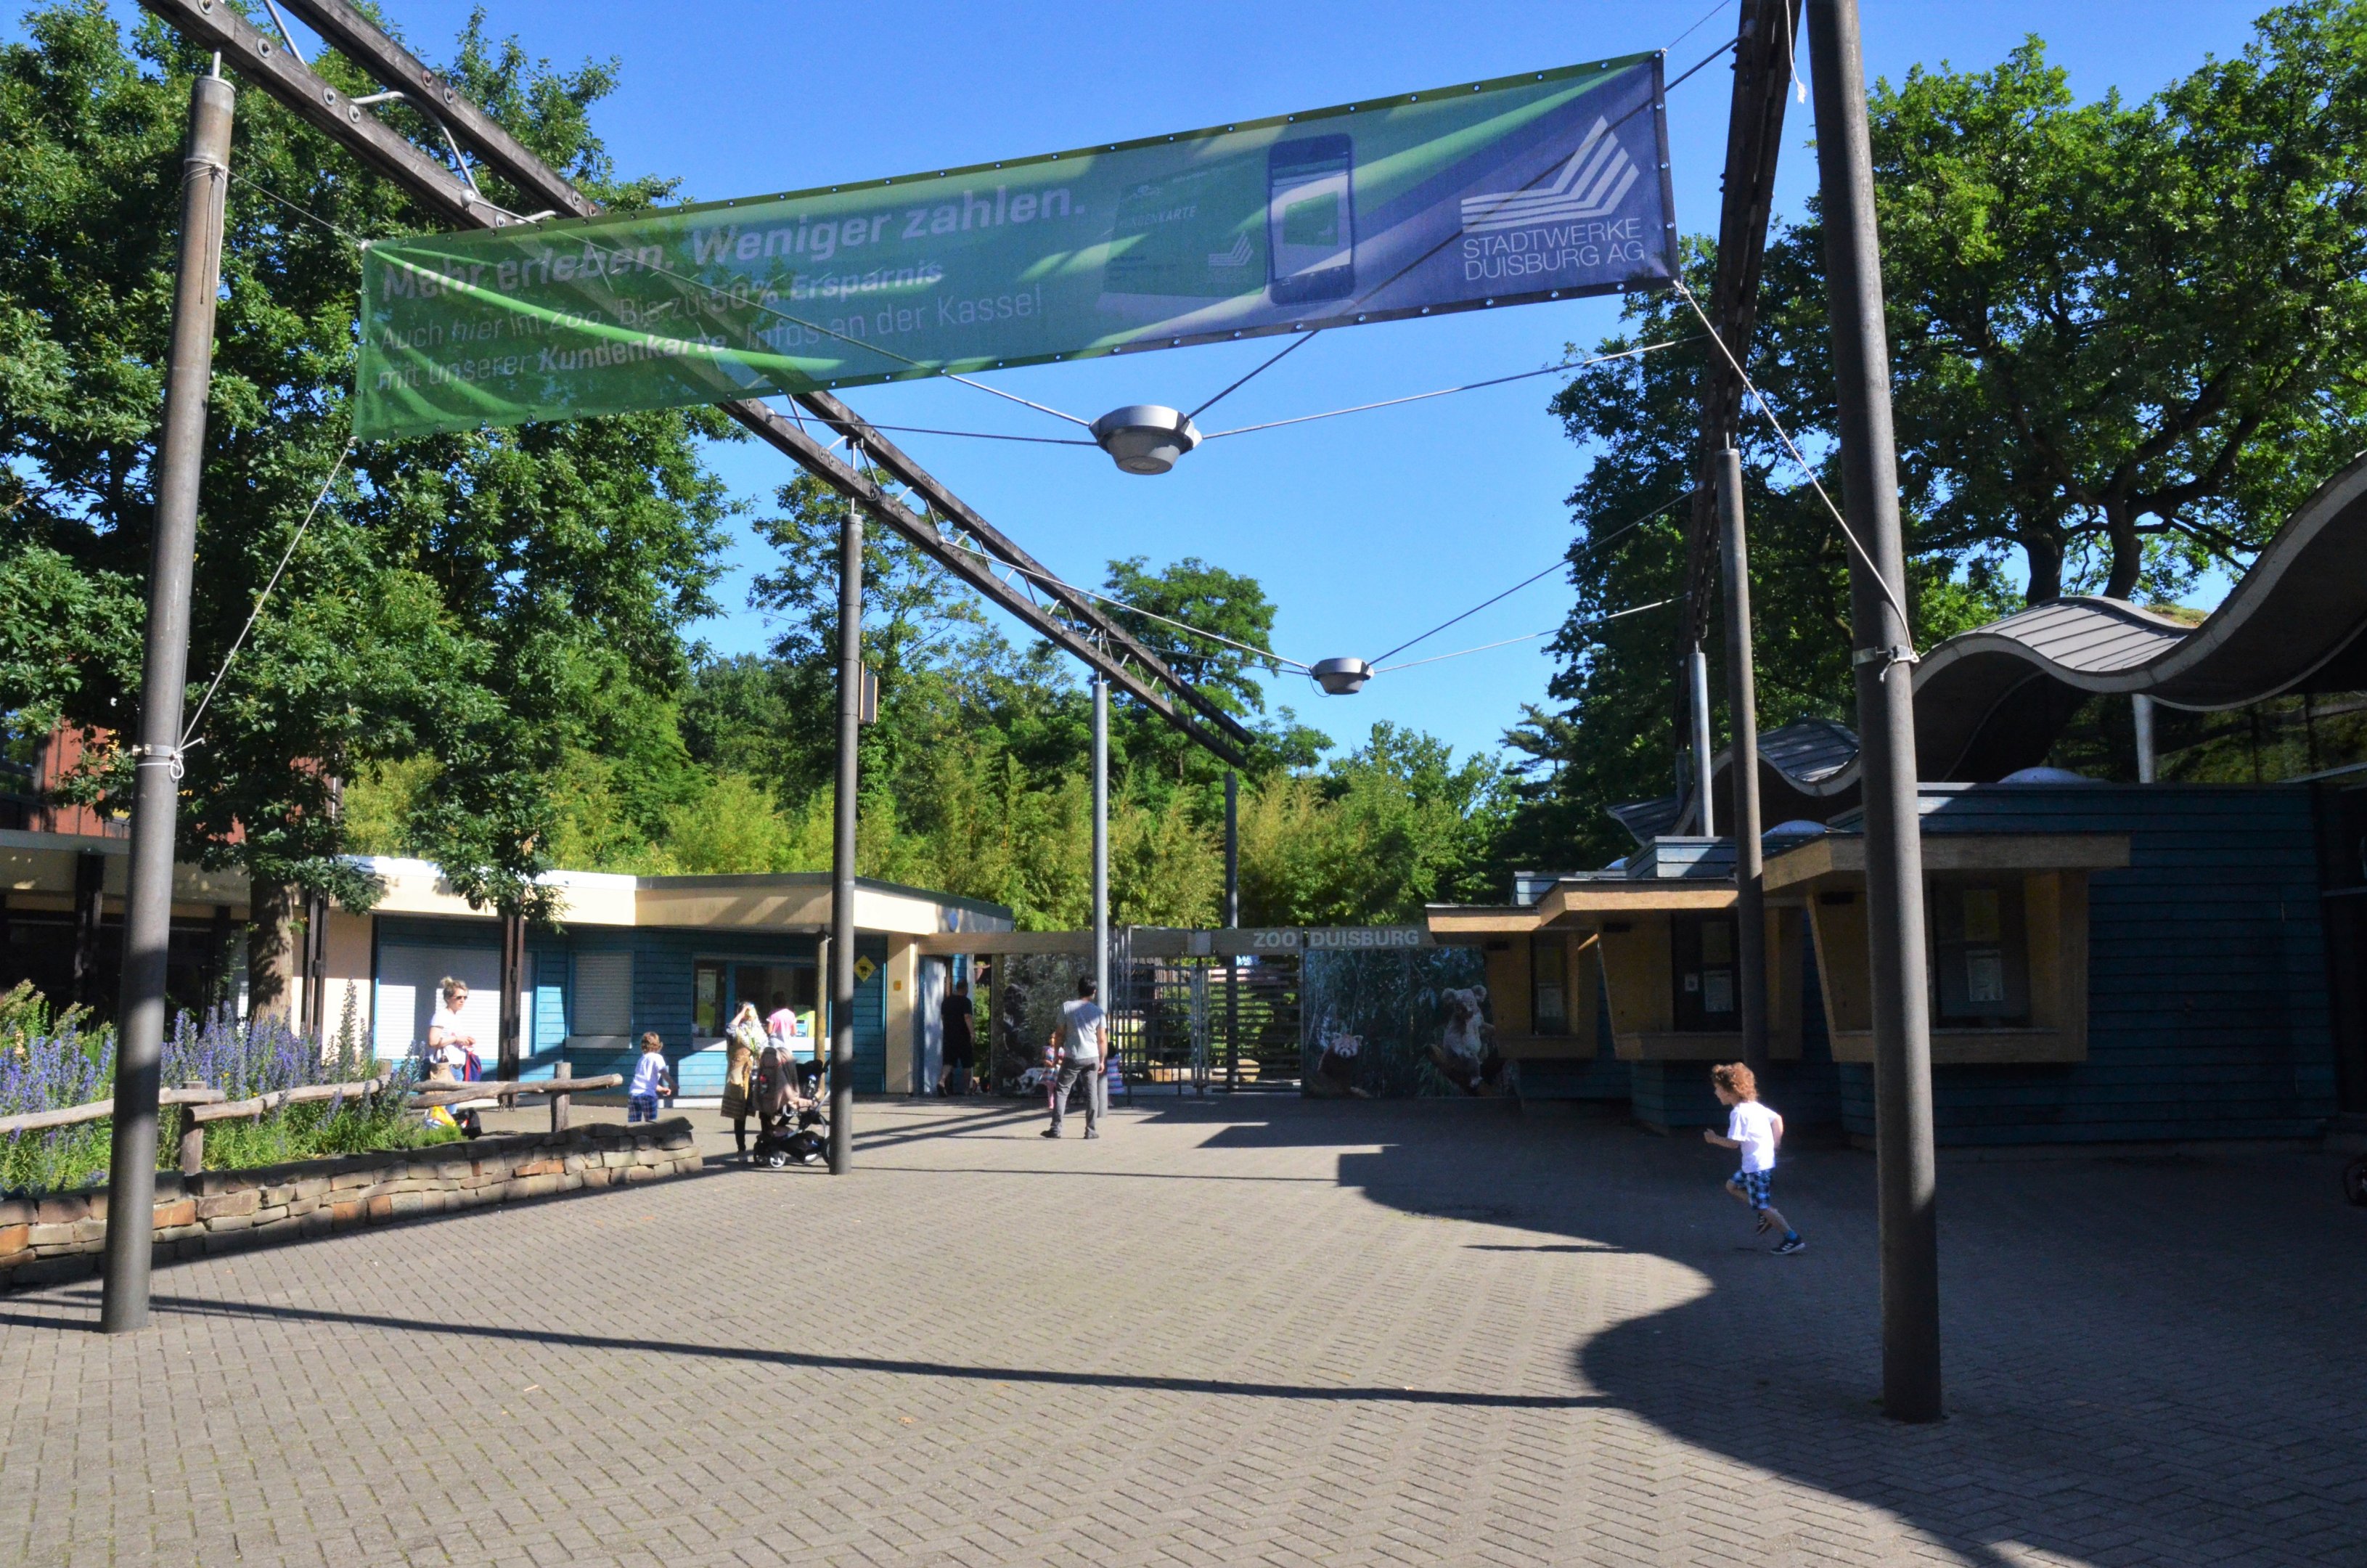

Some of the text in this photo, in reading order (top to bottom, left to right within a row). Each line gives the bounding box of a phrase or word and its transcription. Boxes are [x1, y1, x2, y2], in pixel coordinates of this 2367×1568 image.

[382, 185, 1086, 302] Mehr erleben. Weniger zahlen.
[1463, 218, 1643, 260] STADTWERKE
[1464, 241, 1646, 281] DUISBURG AG
[379, 319, 443, 351] Auch
[451, 317, 502, 343] hier
[510, 309, 540, 336] im
[618, 298, 661, 326] Bis
[671, 296, 701, 319] zu
[711, 279, 777, 313] 50%
[790, 259, 945, 302] Ersparnis
[375, 362, 420, 391] mit
[429, 351, 530, 385] unserer
[746, 318, 819, 349] Infos
[832, 316, 866, 341] an
[876, 303, 927, 336] der
[1253, 929, 1420, 948] ZOO DUISBURG
